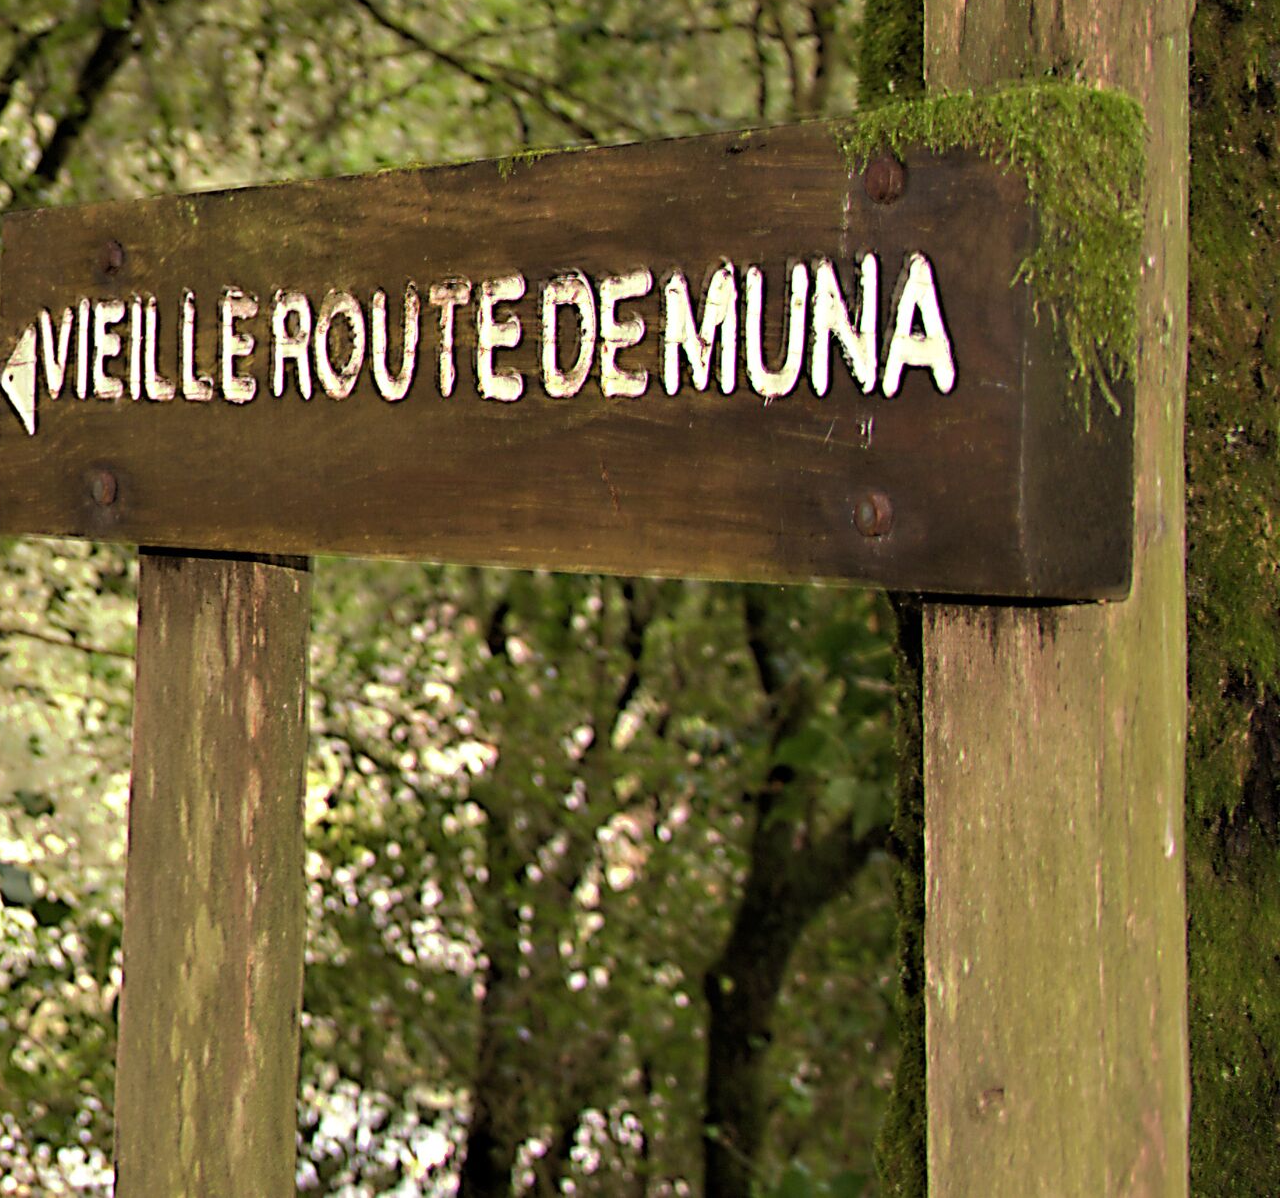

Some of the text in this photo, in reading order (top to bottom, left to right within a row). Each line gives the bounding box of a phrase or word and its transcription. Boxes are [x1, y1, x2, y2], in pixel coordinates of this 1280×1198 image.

[38, 251, 958, 404] VIEILLE ROUTE DE MUNA
